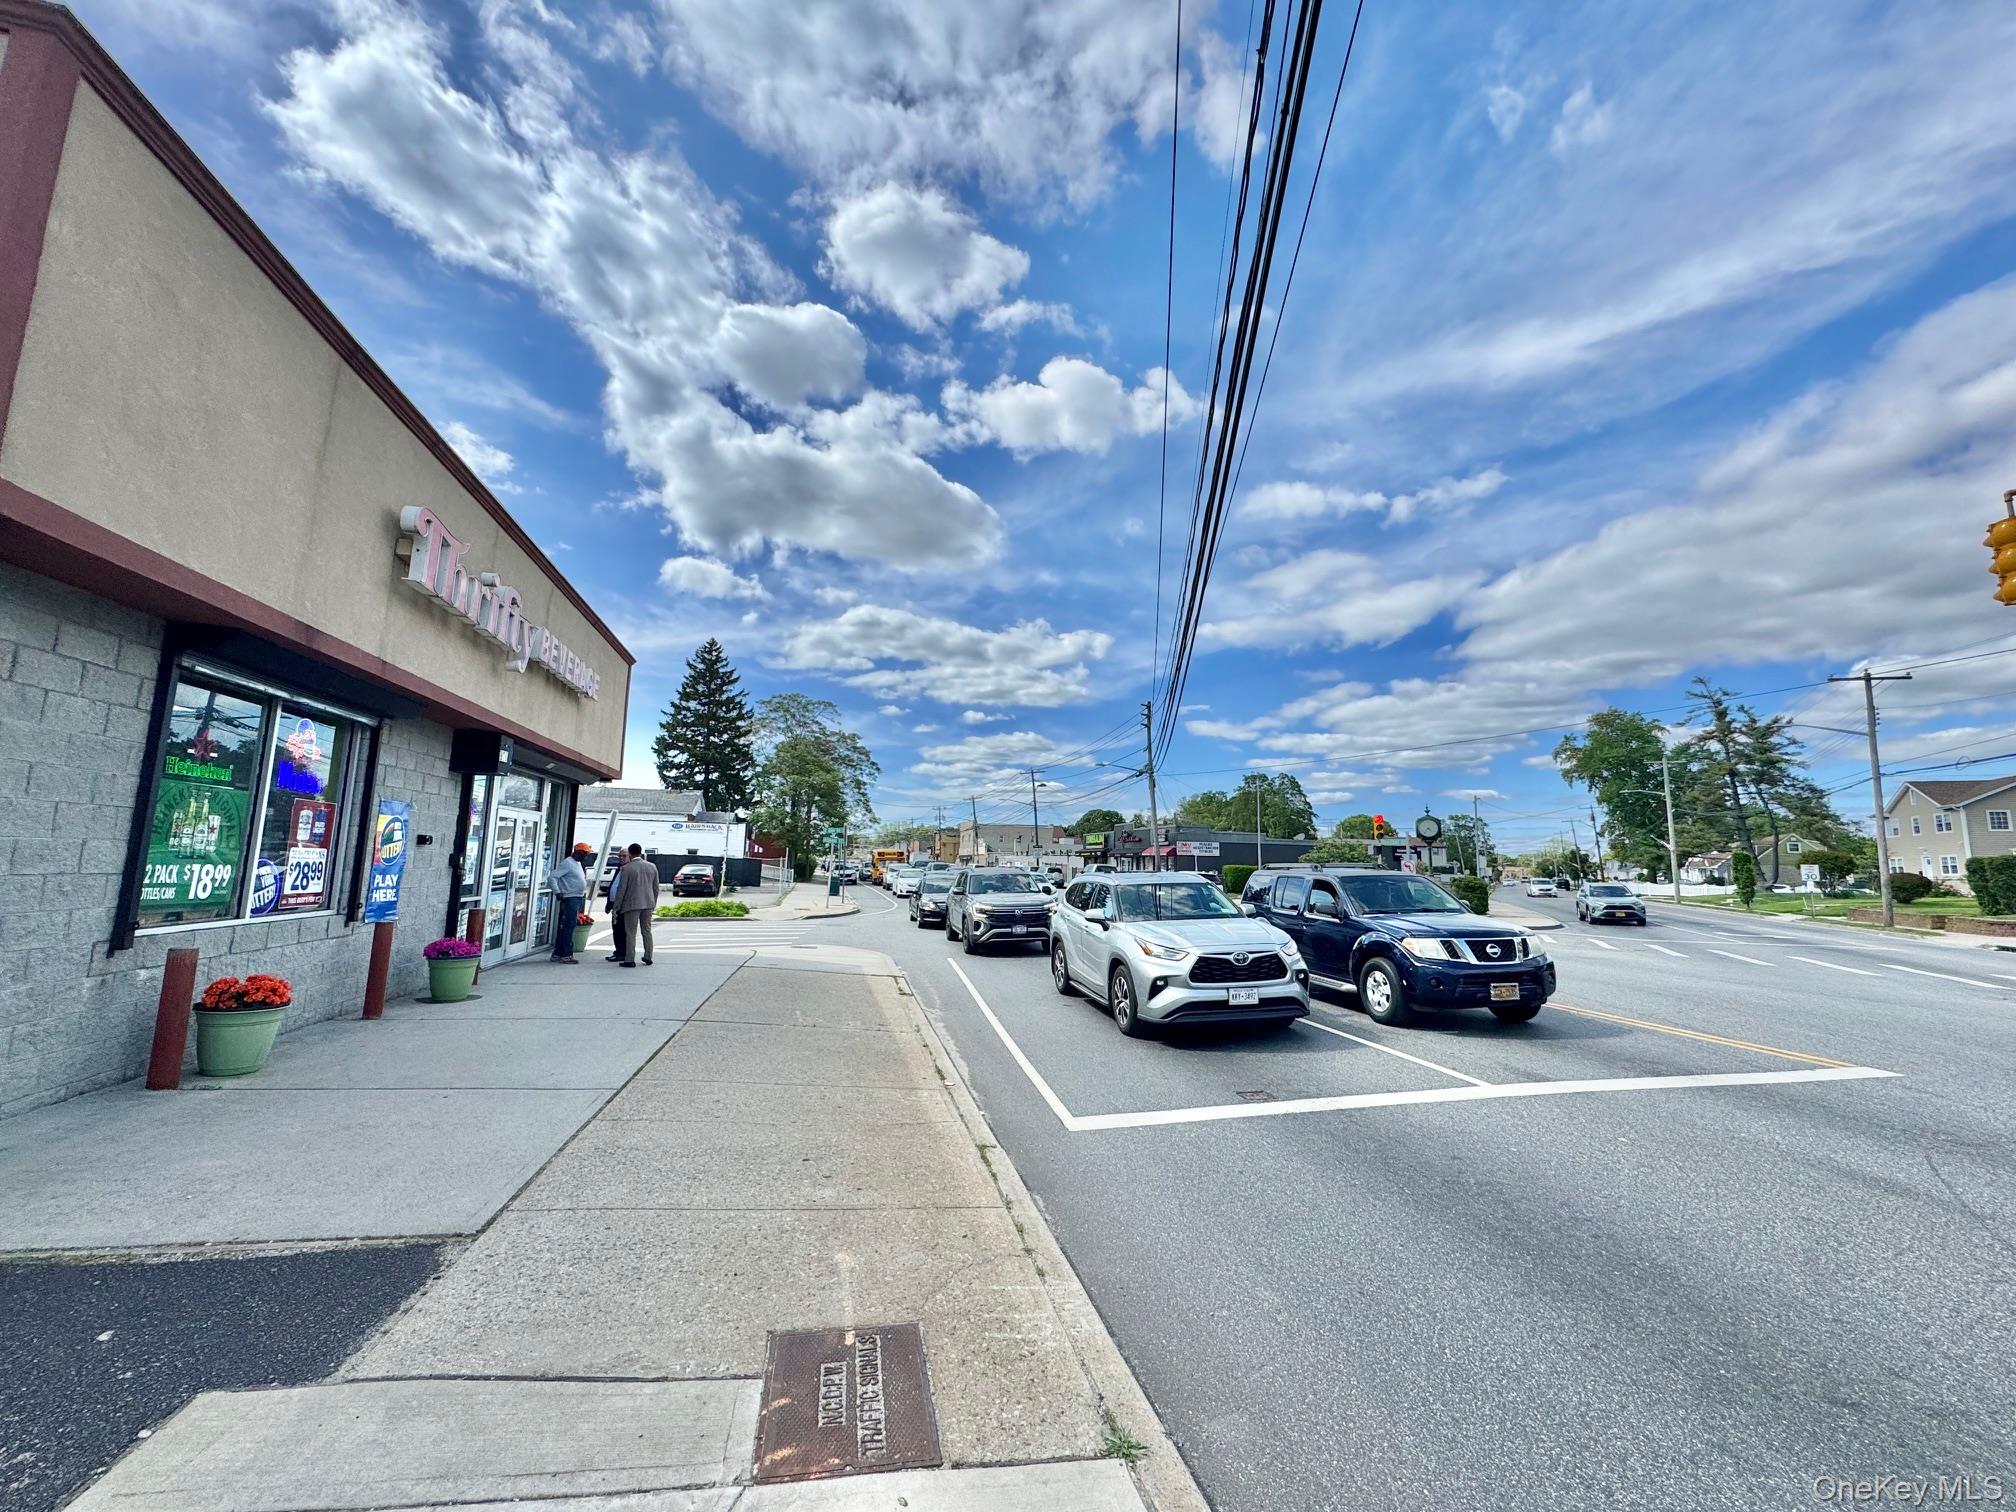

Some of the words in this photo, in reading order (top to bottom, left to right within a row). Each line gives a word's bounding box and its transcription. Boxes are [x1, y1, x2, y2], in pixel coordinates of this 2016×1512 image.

[401, 506, 539, 674] Thrifty
[537, 626, 601, 702] BEVERAGE
[165, 755, 232, 782] Heineken
[153, 864, 180, 884] PACK
[374, 874, 399, 888] PLAY
[140, 886, 176, 901] OTTLES/CANS
[372, 888, 398, 903] HERE
[857, 1335, 882, 1387] SIGNALS
[859, 1390, 885, 1456] TRAFFIC
